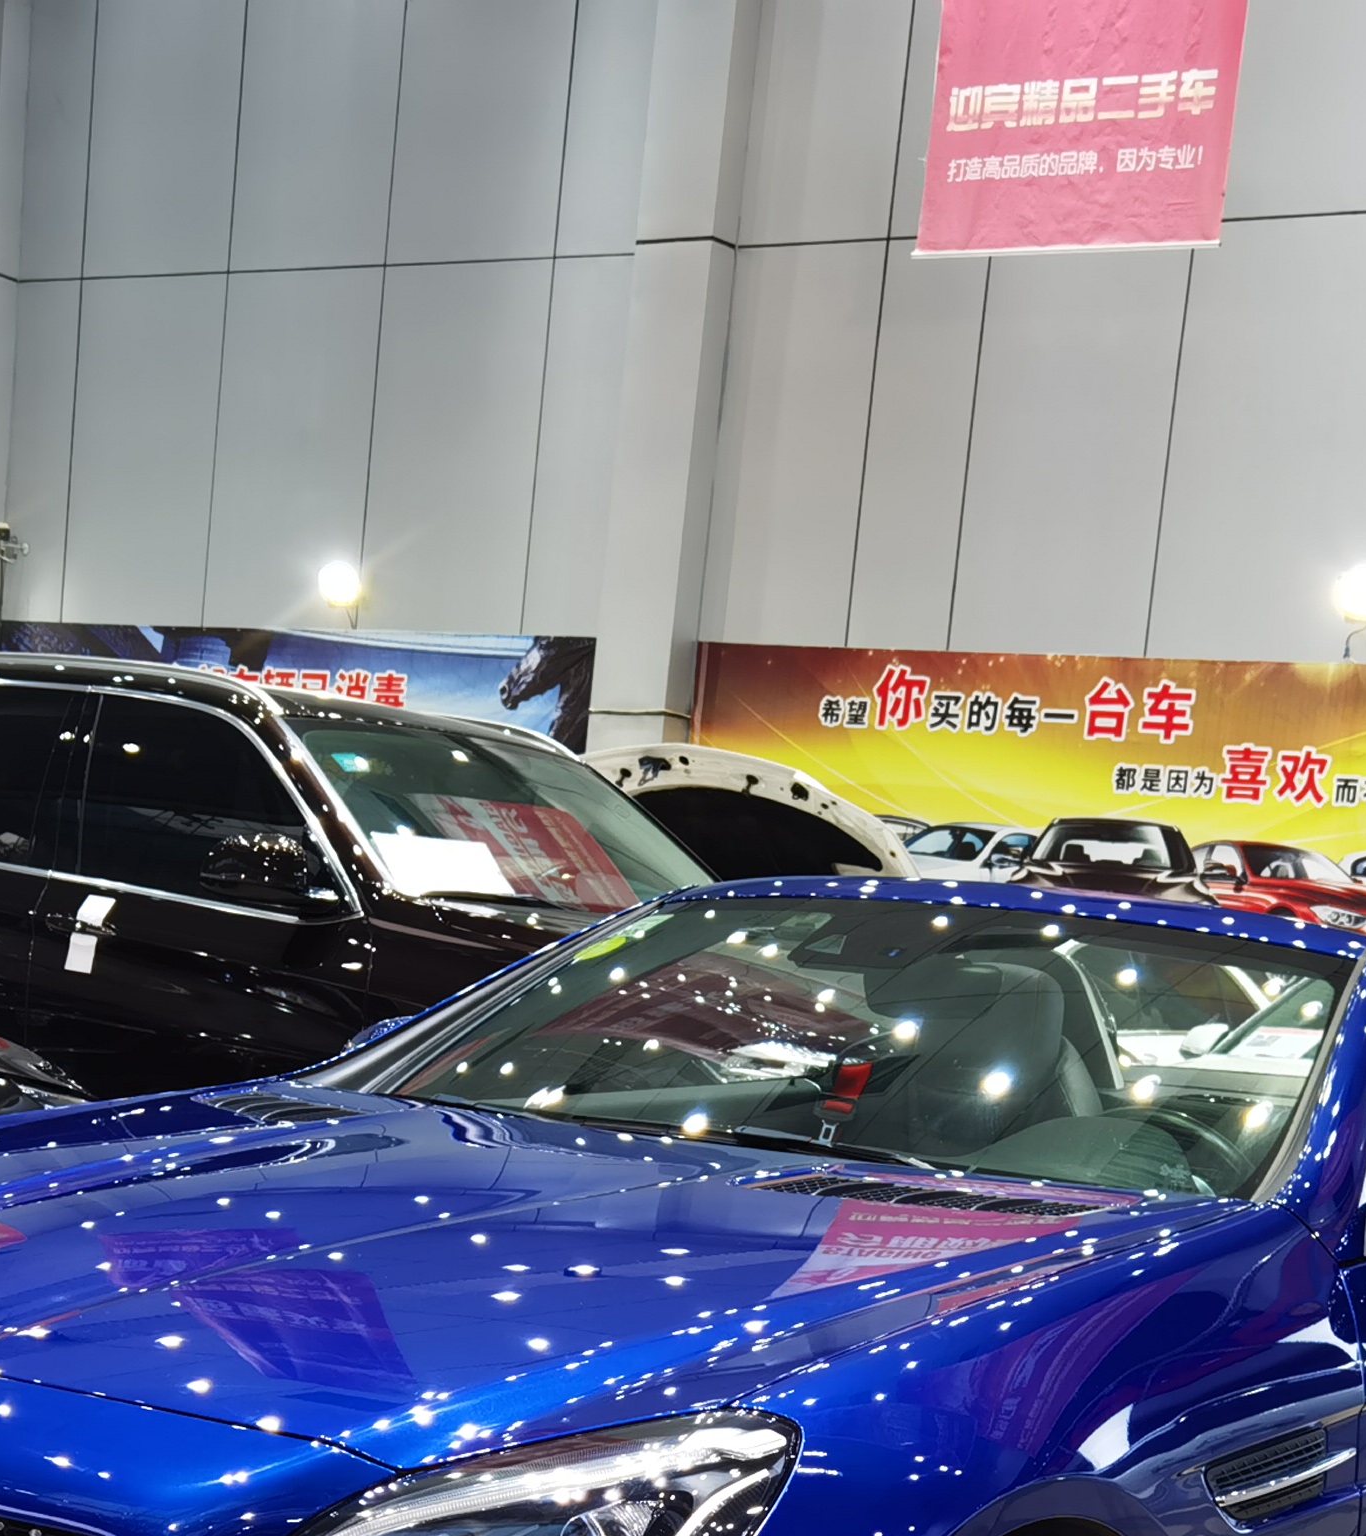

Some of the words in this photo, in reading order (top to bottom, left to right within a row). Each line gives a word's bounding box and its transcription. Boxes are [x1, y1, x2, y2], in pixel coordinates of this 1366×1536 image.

[946, 69, 1219, 131] 迎宾精品二手车
